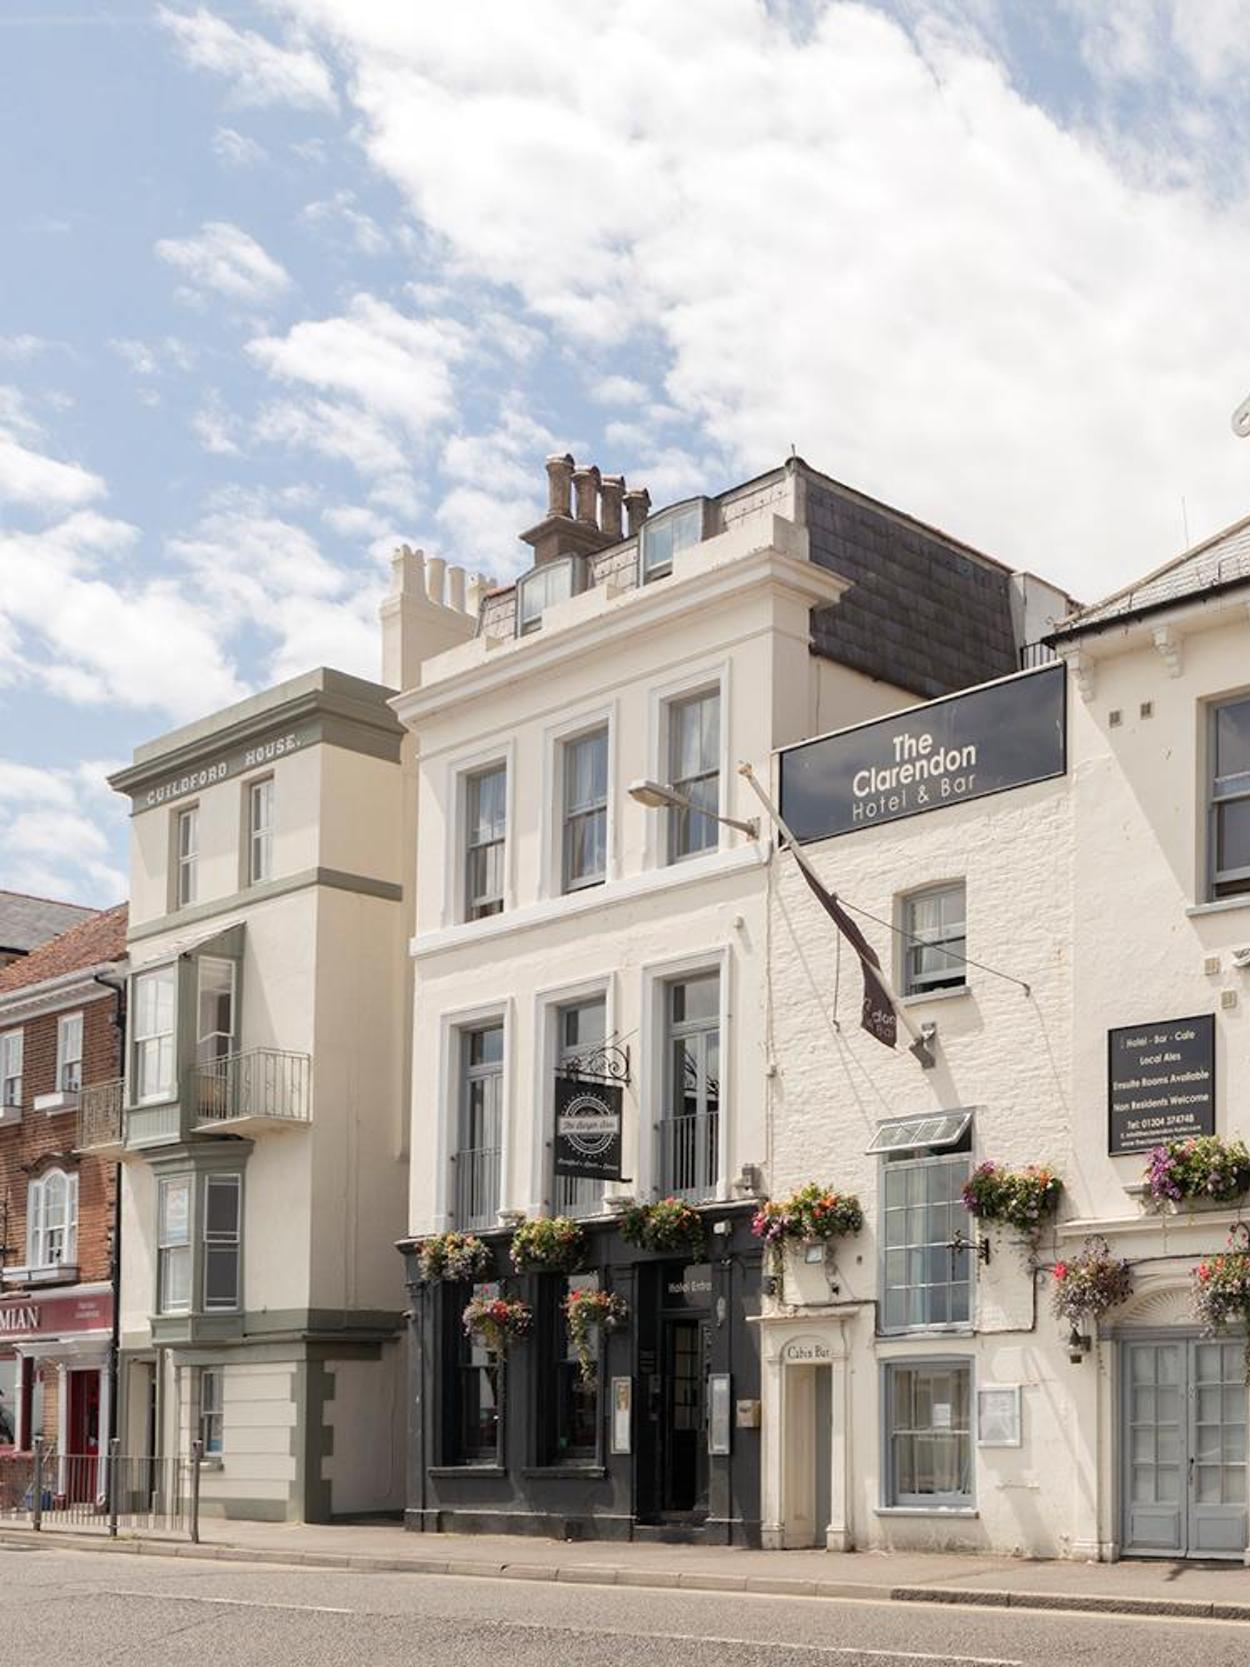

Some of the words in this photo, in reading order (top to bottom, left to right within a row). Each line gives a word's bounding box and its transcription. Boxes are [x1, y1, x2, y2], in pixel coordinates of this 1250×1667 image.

[892, 733, 933, 762] The
[147, 762, 228, 805] GUILDFORD
[853, 745, 977, 797] Clarendon
[852, 787, 906, 821] Hotel
[918, 784, 930, 804] &
[941, 774, 976, 797] Bar
[1126, 1036, 1147, 1048] Hotel
[1154, 1034, 1168, 1044] Bar
[1140, 1052, 1162, 1066] Local
[1163, 1051, 1181, 1062] Ales
[1113, 1079, 1140, 1091] Ensuite
[1142, 1076, 1169, 1087] Rooms
[1170, 1069, 1210, 1083] Available
[1113, 1103, 1130, 1112] Non
[1131, 1097, 1169, 1110] Residents
[1170, 1093, 1209, 1105] Welcome
